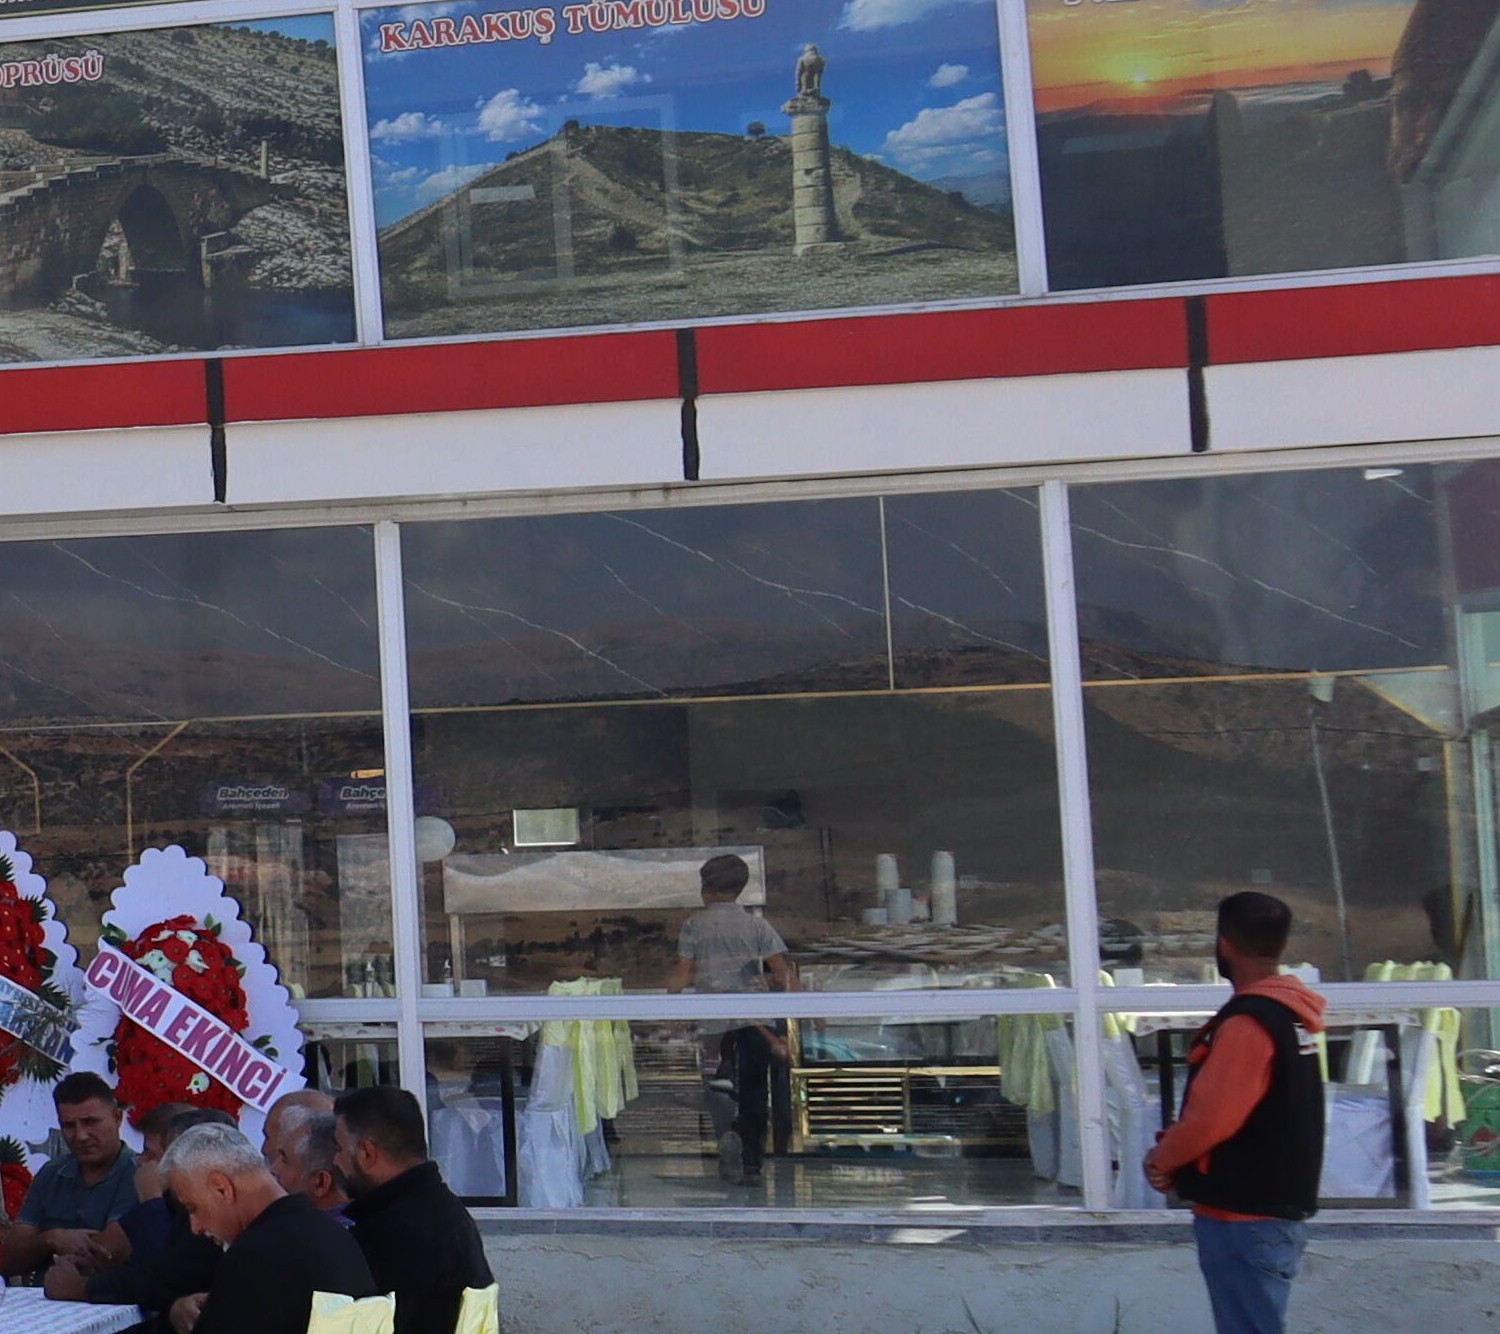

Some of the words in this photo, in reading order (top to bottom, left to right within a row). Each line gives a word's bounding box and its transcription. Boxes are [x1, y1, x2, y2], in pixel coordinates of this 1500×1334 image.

[379, 8, 555, 52] KARAKUŞ
[340, 785, 386, 801] Bahçe
[163, 1004, 288, 1107] EKİNCİ
